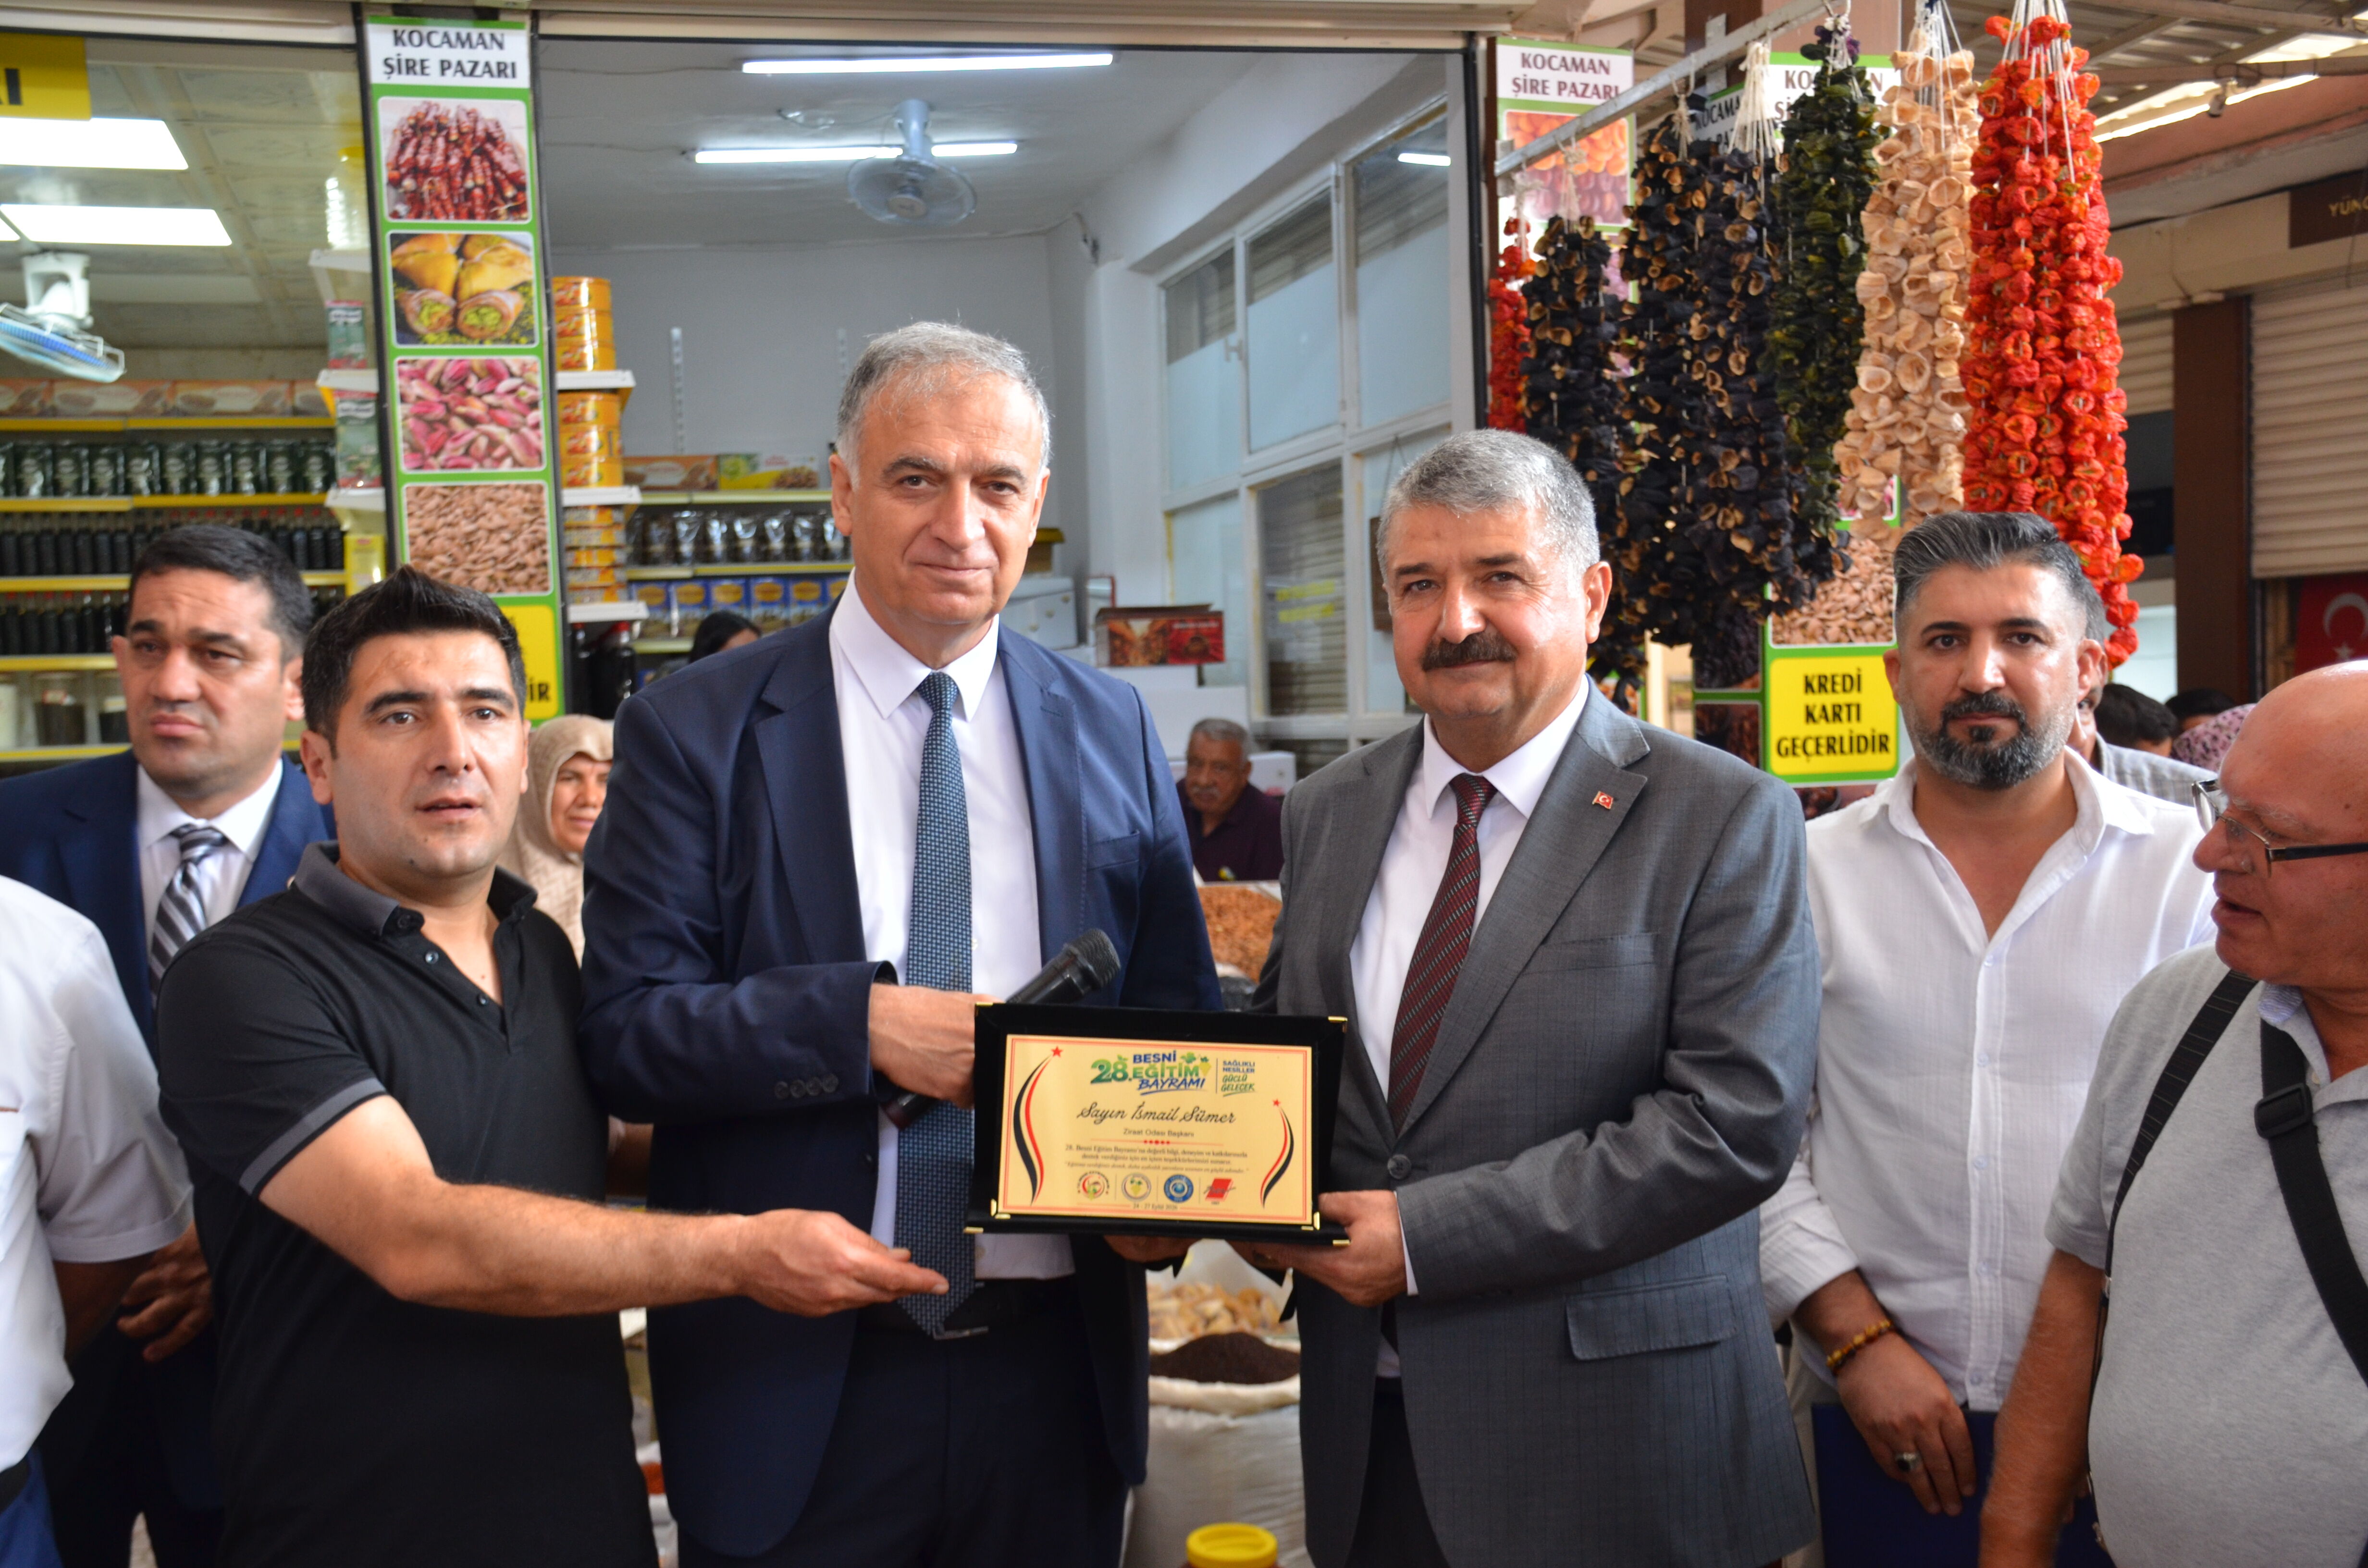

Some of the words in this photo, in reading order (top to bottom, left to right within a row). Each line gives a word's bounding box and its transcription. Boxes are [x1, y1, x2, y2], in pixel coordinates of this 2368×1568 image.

[393, 29, 505, 50] KOCAMAN
[383, 53, 431, 80] ŞİRE
[439, 59, 517, 79] PAZARI
[1521, 52, 1611, 75] KOCAMAN
[1512, 74, 1551, 98] ŞİRE
[1557, 81, 1619, 99] PAZARI
[1804, 667, 1862, 694] KREDİ
[1805, 703, 1862, 724] KARTI
[1776, 728, 1890, 763] GEÇERLİDİR
[1133, 1050, 1177, 1064] BESNİ
[1091, 1059, 1132, 1084] 28.
[1133, 1062, 1199, 1078] EĞİTİM
[1137, 1078, 1206, 1090] BAYRAMI
[1221, 1083, 1255, 1092] GELECEK
[1076, 1102, 1128, 1125] Sayın
[1131, 1101, 1179, 1122] İsmail
[1179, 1105, 1236, 1124] Sümer
[1168, 1130, 1194, 1138] Başkanı
